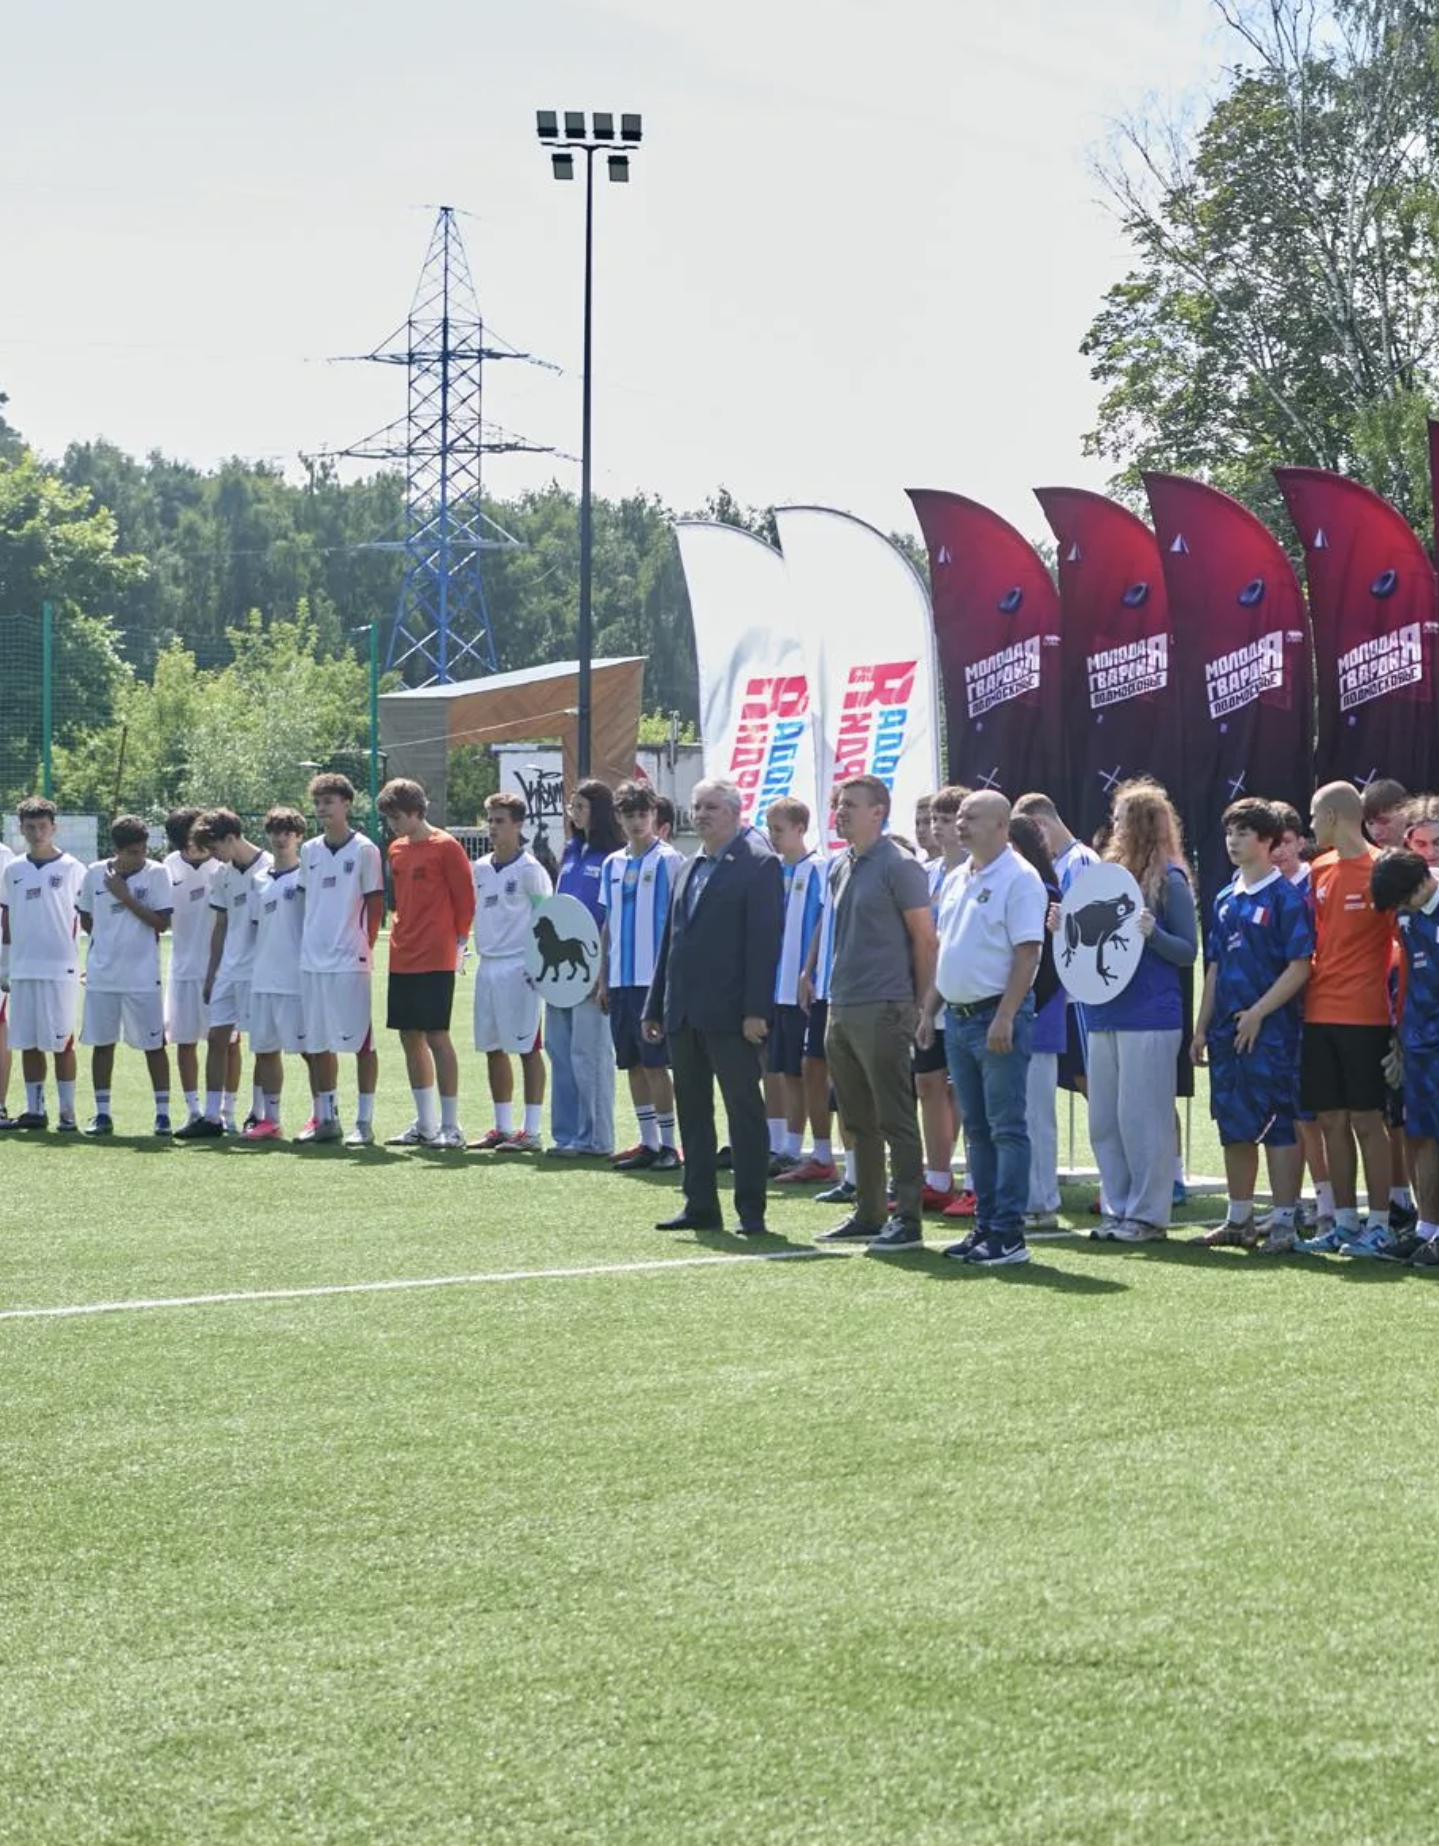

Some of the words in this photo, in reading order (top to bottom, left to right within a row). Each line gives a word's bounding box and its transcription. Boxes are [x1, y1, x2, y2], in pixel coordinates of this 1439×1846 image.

[964, 634, 1040, 682] МОЛОДАЯ
[1087, 632, 1167, 673] МОЛОДАЯ
[1338, 621, 1421, 676] МОЛОДАЯ
